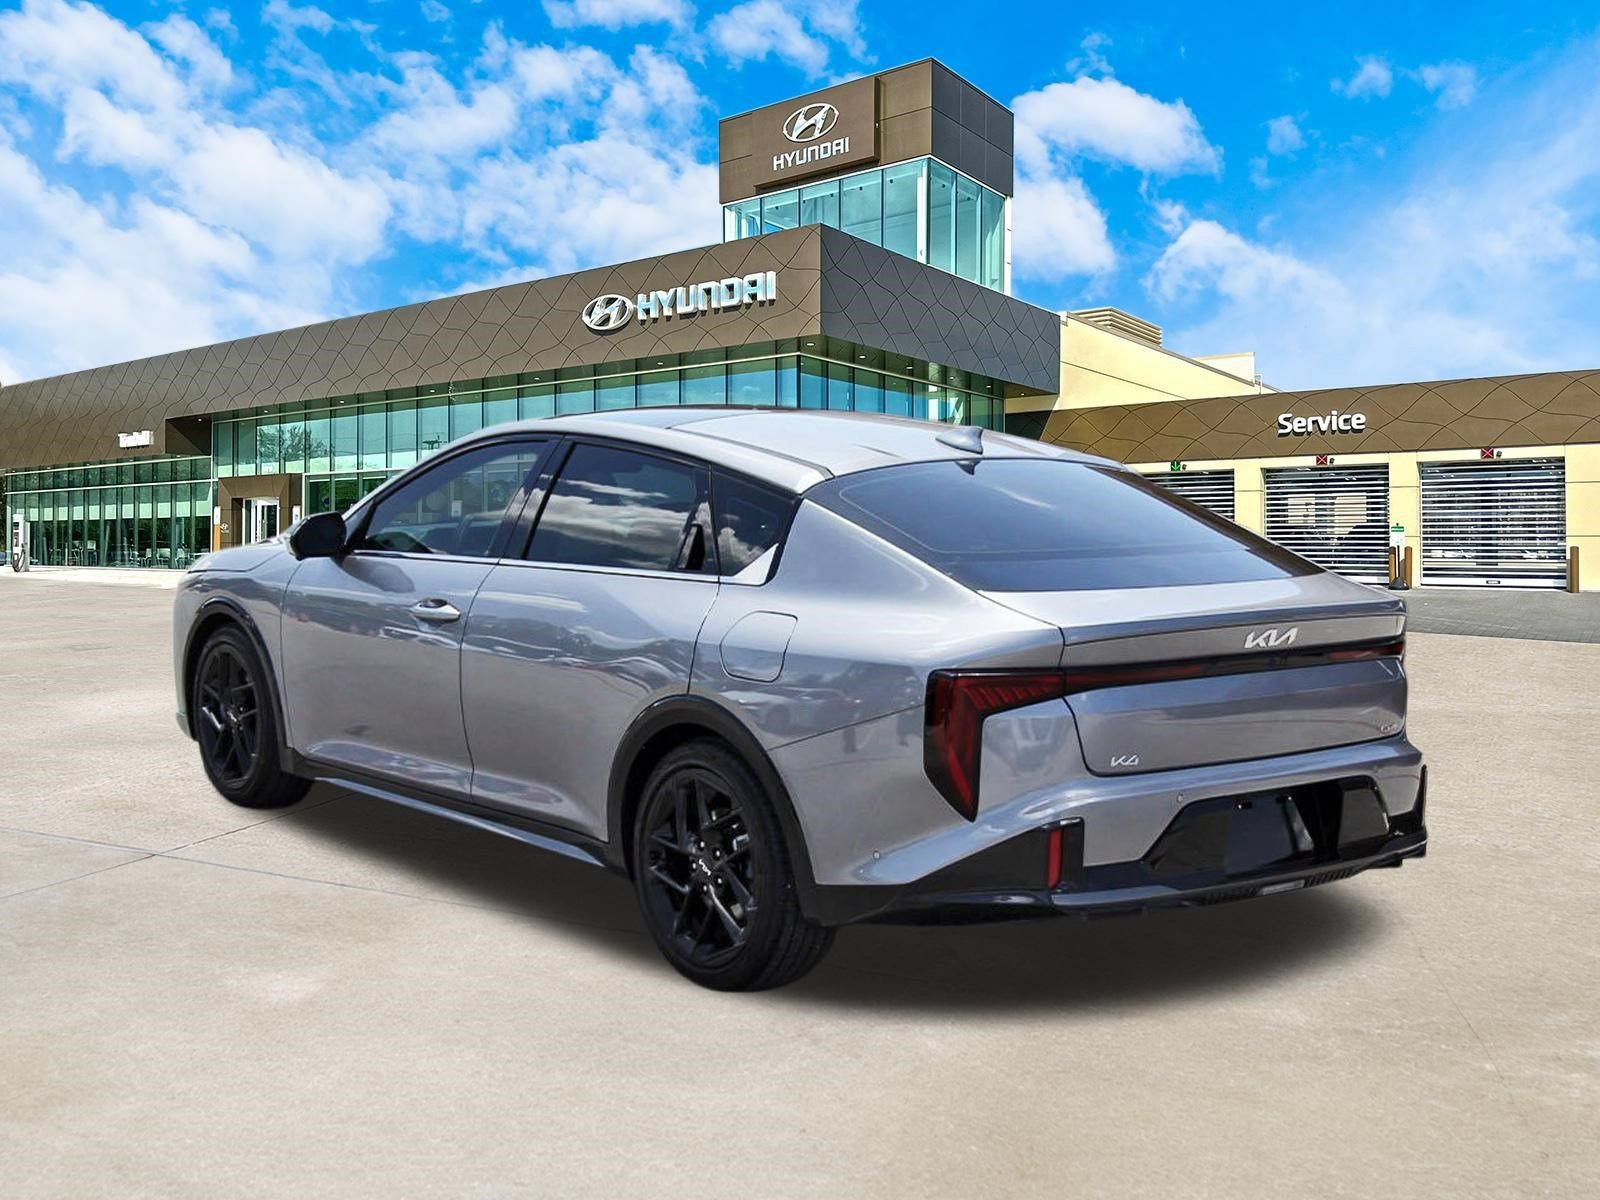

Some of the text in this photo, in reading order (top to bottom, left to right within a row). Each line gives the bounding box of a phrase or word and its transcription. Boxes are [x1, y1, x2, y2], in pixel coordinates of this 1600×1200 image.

[773, 136, 850, 171] HYUNDAI
[637, 270, 777, 321] HYUNDAI
[1278, 410, 1366, 434] Service
[1244, 627, 1298, 649] KIA
